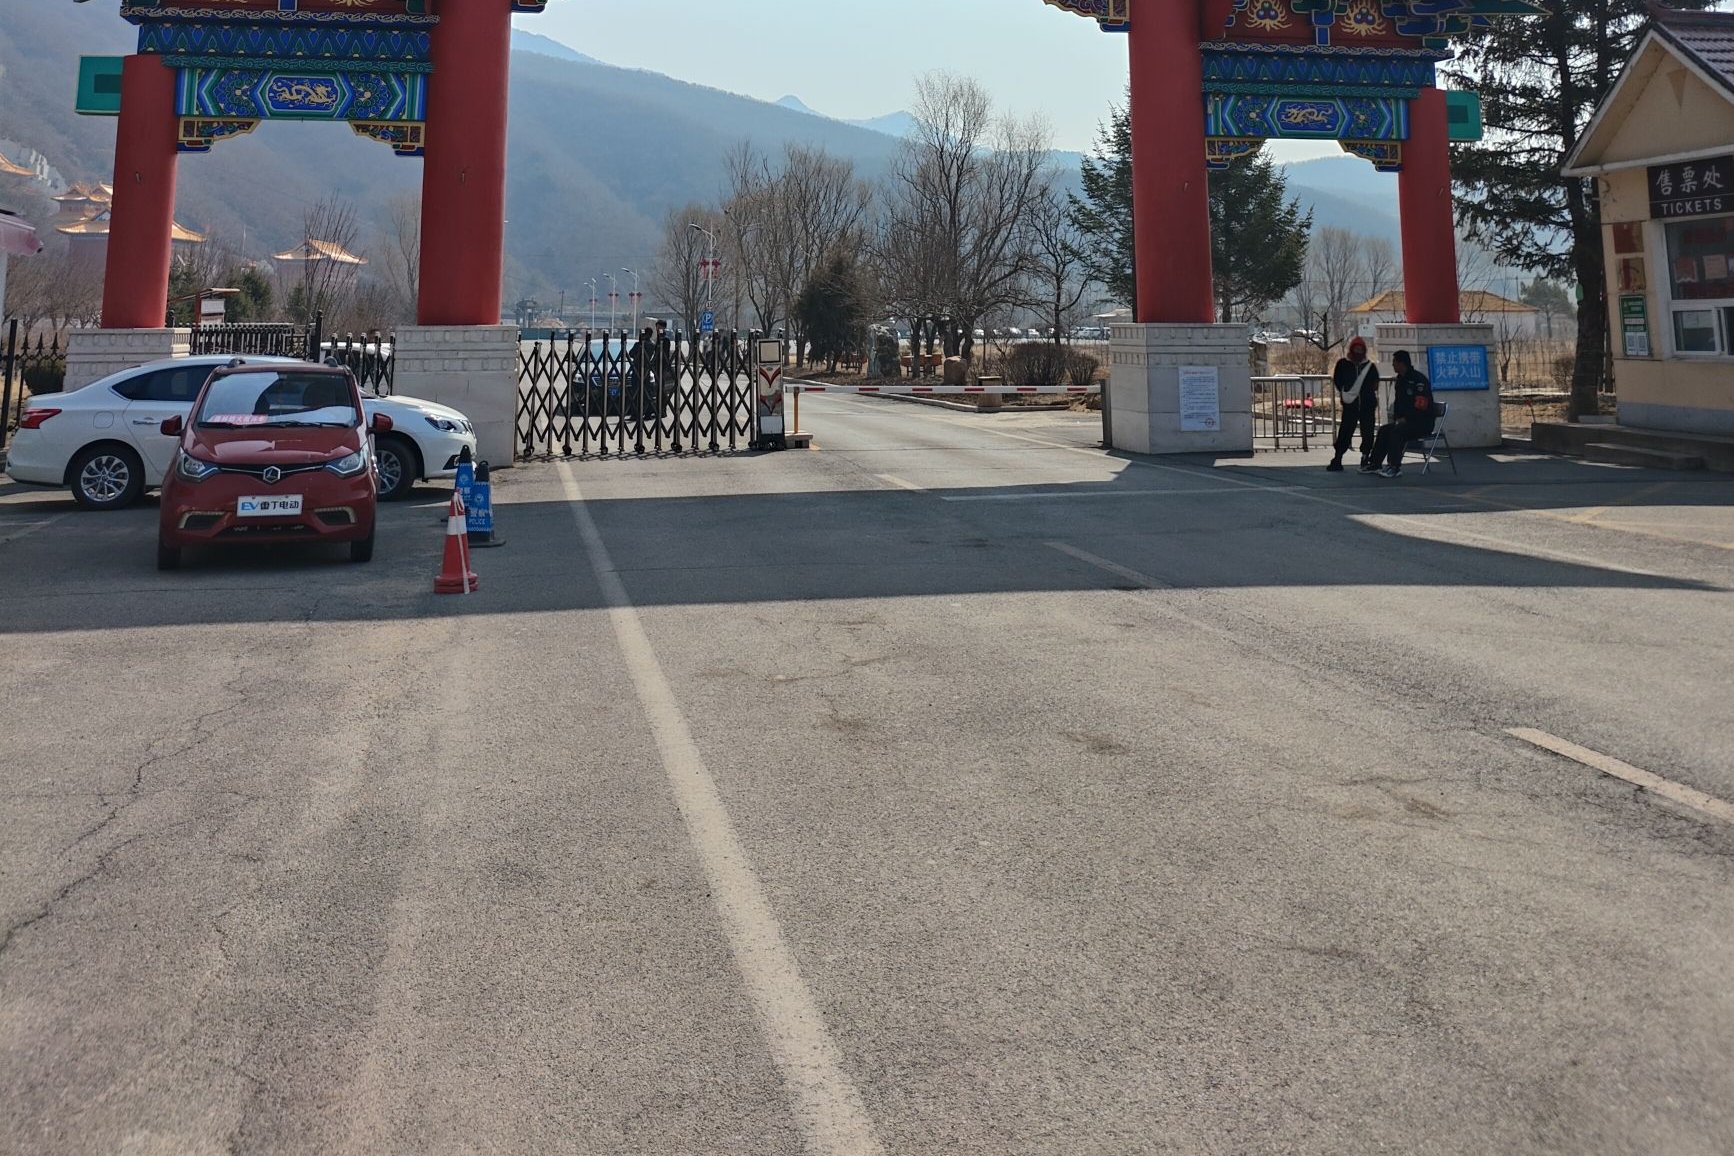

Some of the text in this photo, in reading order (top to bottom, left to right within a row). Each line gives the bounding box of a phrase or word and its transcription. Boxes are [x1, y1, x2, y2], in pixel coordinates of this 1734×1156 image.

[1656, 165, 1724, 195] 售票处
[1661, 198, 1722, 216] TICKETS
[1436, 365, 1481, 379] 火种入山
[241, 501, 259, 511] EV
